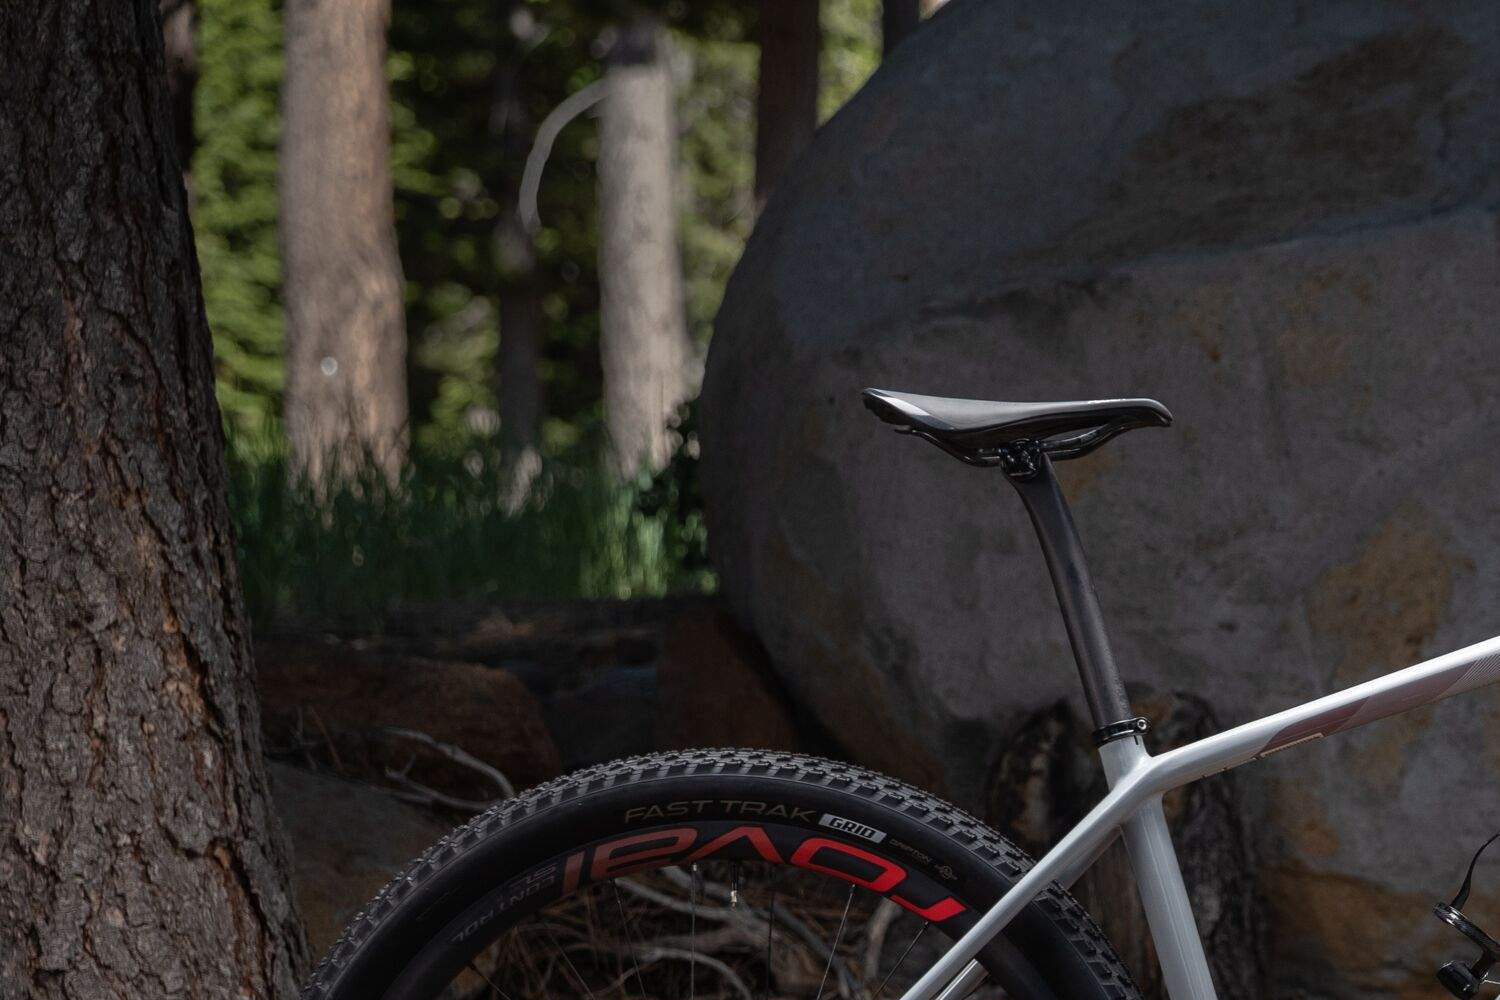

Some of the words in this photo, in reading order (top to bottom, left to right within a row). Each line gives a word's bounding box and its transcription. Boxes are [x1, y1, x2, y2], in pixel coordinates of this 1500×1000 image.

[624, 800, 714, 824] FAST
[720, 799, 817, 823] TRAK
[829, 817, 876, 840] GRID
